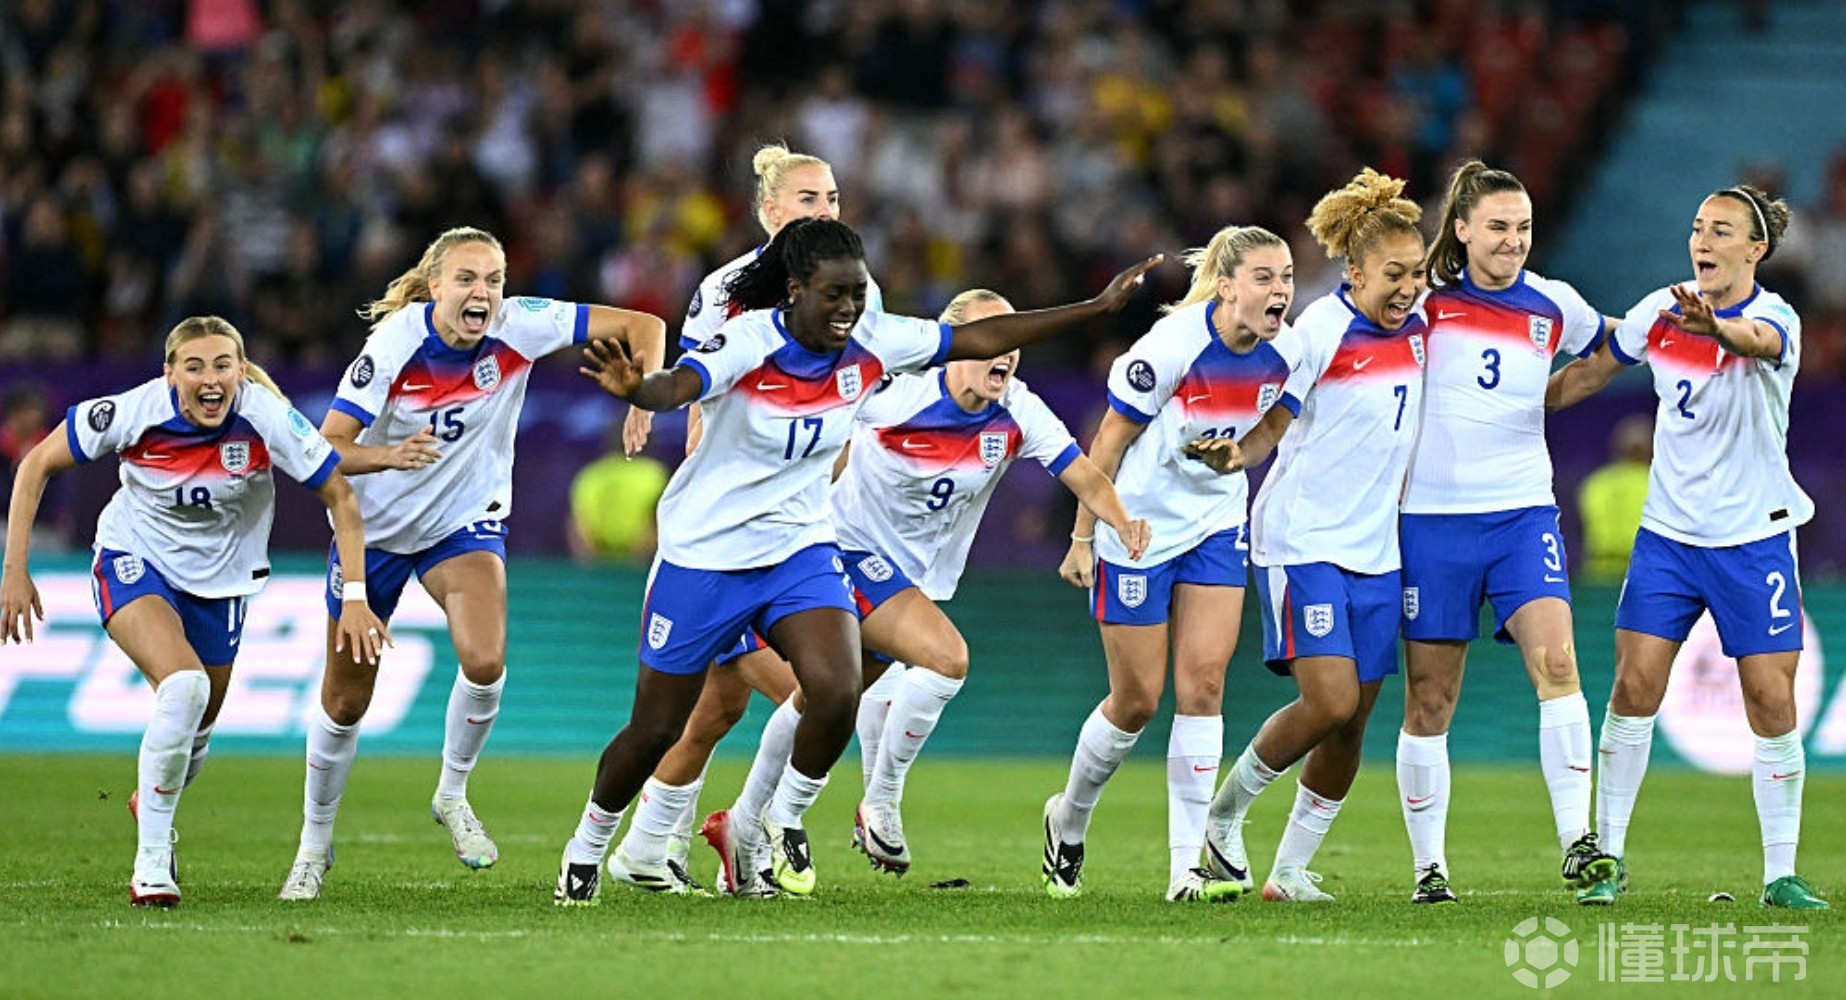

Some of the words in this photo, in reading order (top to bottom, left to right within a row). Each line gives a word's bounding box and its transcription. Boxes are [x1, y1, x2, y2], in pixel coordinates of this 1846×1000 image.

[1477, 348, 1500, 390] 3
[1394, 384, 1407, 431] 7
[1677, 379, 1695, 419] 2
[430, 407, 465, 442] 15
[784, 418, 823, 460] 17
[926, 477, 955, 511] 9
[1542, 532, 1562, 571] 3
[1766, 572, 1791, 618] 2
